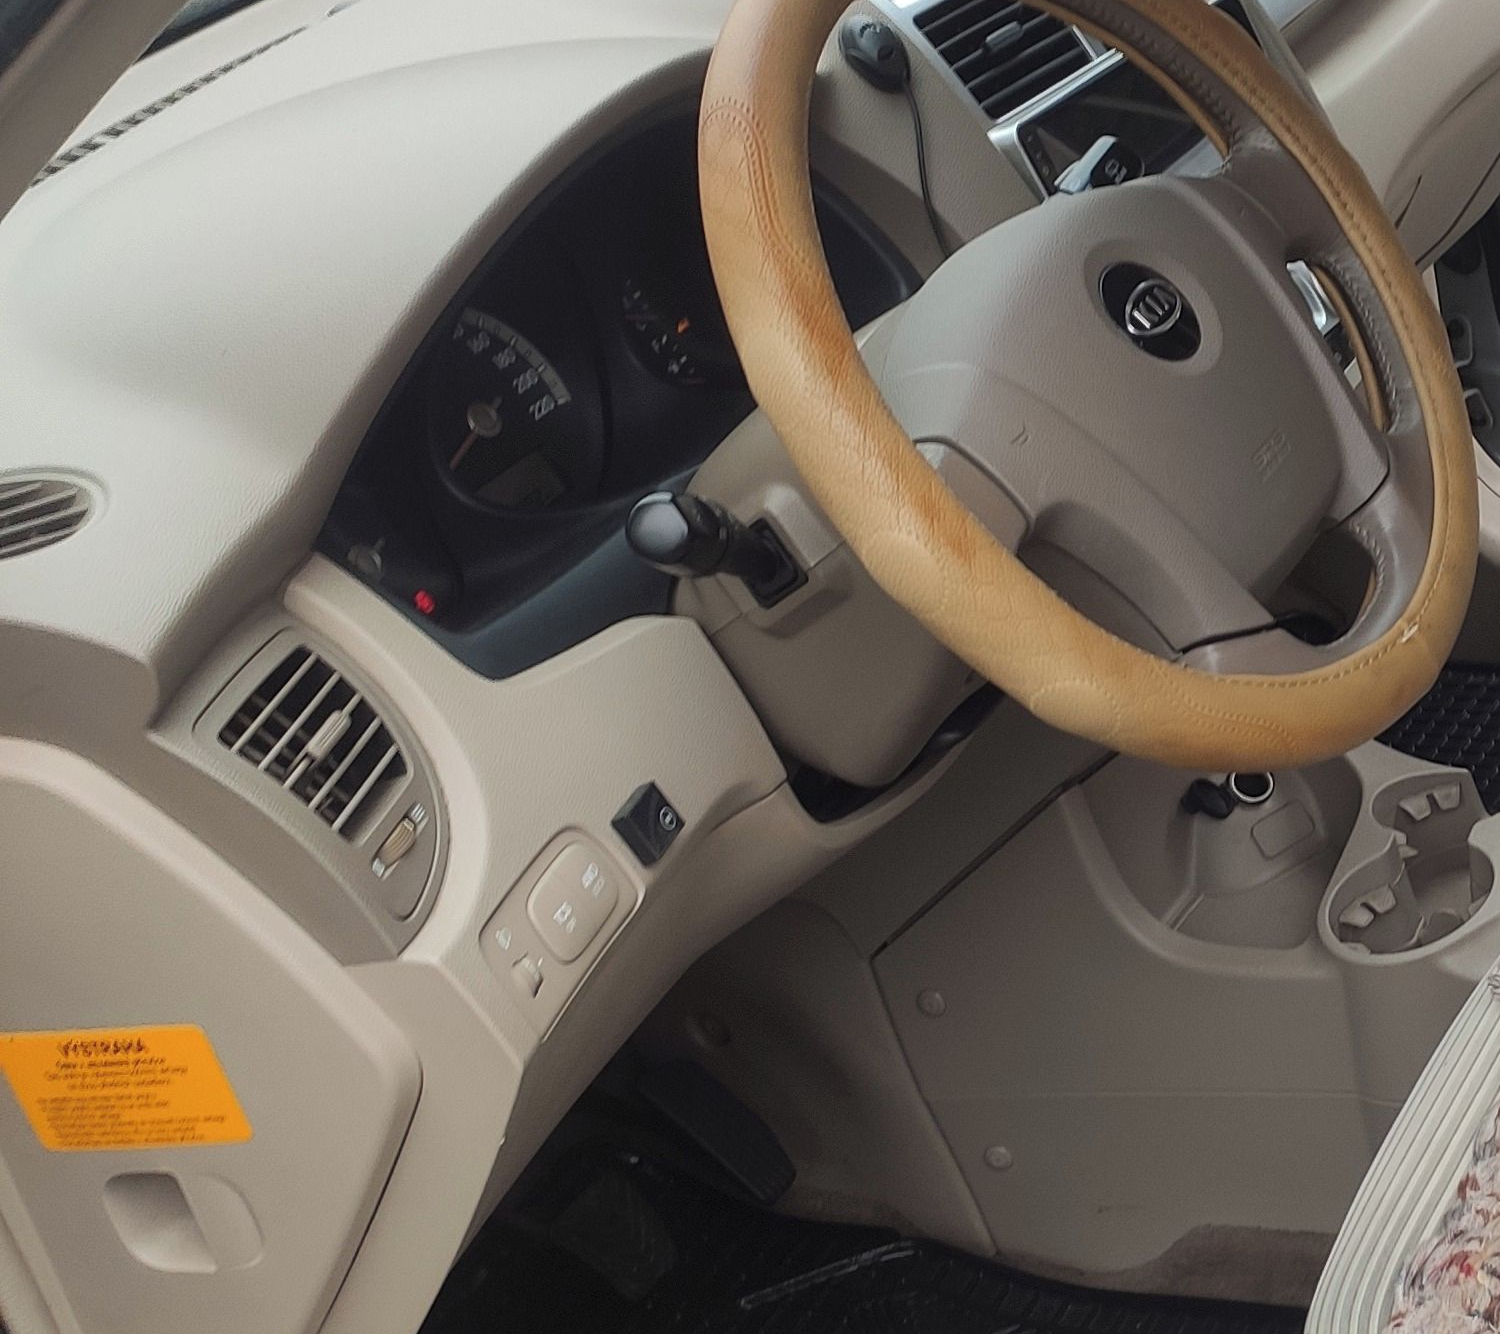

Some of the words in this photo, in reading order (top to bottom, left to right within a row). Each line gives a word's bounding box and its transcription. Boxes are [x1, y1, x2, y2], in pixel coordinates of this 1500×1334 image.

[1132, 284, 1177, 330] KIA
[513, 367, 538, 395] 200
[529, 393, 555, 421] 220
